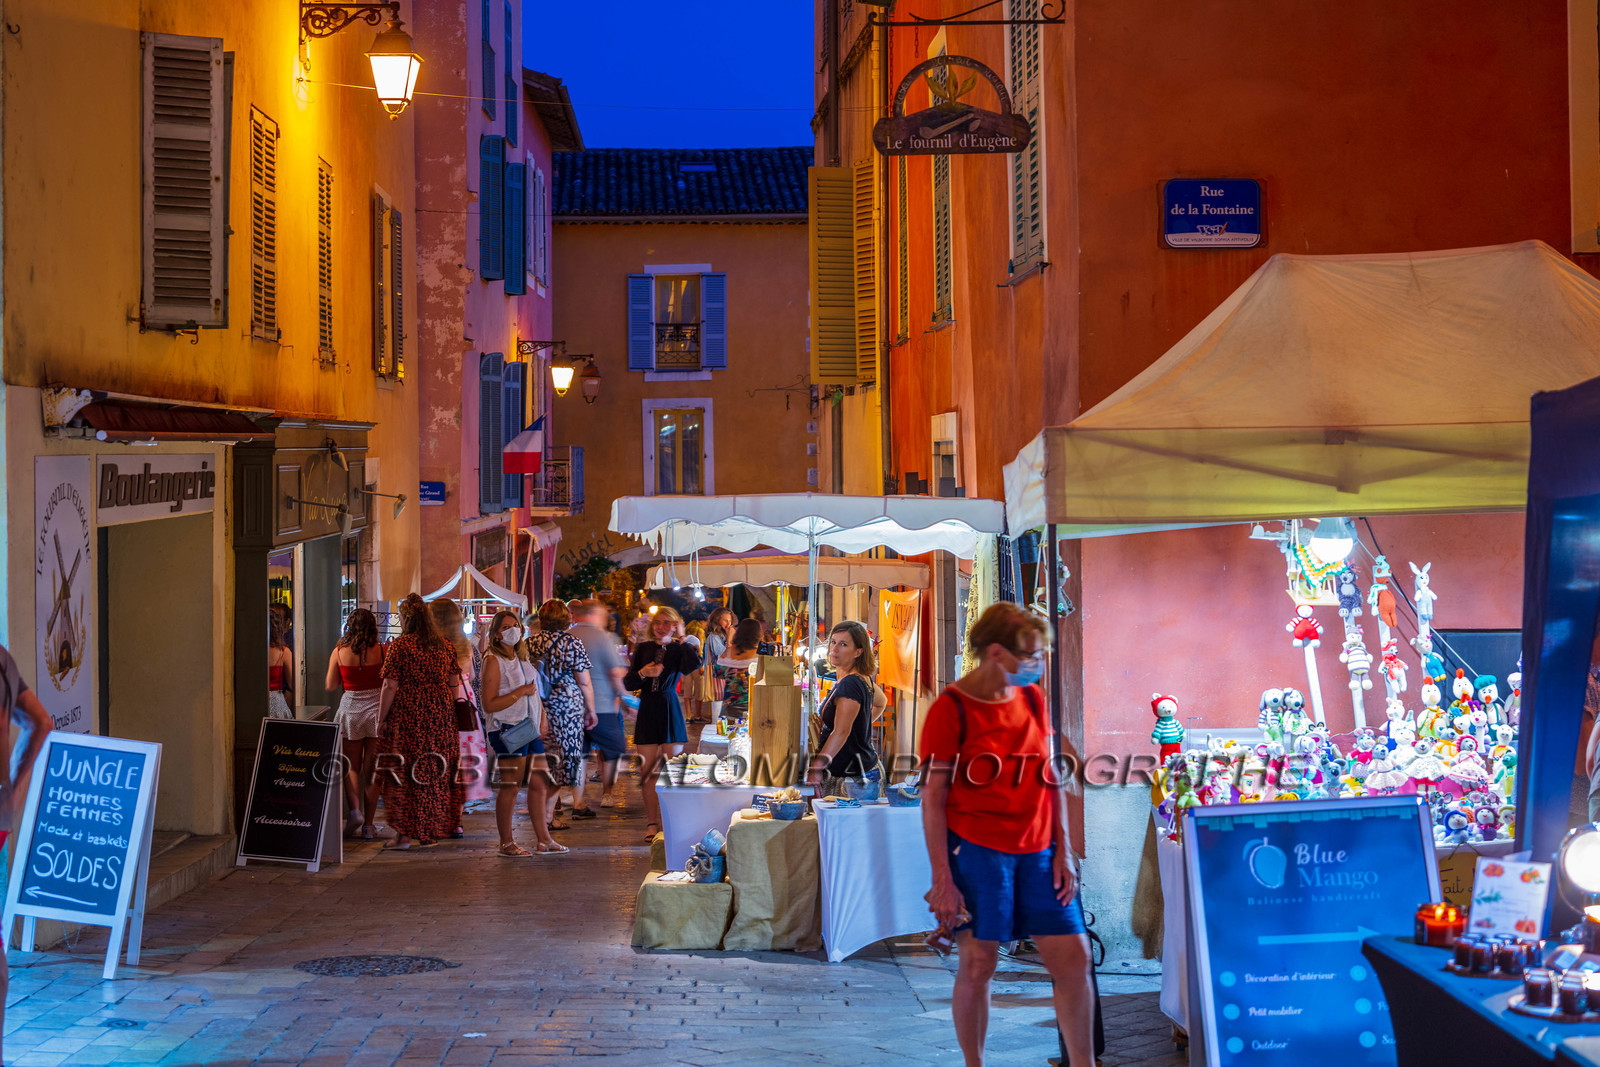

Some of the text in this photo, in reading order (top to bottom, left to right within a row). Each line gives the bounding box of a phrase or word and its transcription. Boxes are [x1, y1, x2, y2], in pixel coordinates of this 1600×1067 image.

[886, 133, 1018, 152] Le fournil d'Eugène
[1200, 185, 1225, 197] Rue
[1170, 203, 1255, 215] de la Fontaine
[99, 461, 216, 513] Boulangerie
[40, 482, 66, 546] FOURNIL
[273, 744, 293, 755] Via
[50, 750, 139, 790] JUNGLE
[277, 763, 307, 774] Bijoux
[273, 777, 306, 789] Argent
[48, 786, 123, 811] HOMMES
[46, 801, 124, 826] FEMMES
[254, 814, 313, 828] Accessoires
[38, 820, 71, 837] Mode
[87, 831, 129, 849] baskets
[1293, 842, 1349, 865] Blue
[33, 842, 122, 890] SOLDES
[1297, 866, 1379, 889] Mango
[1244, 973, 1290, 983] Décoration
[1248, 1006, 1267, 1017] Petit
[1251, 1038, 1290, 1051] Outdoor
